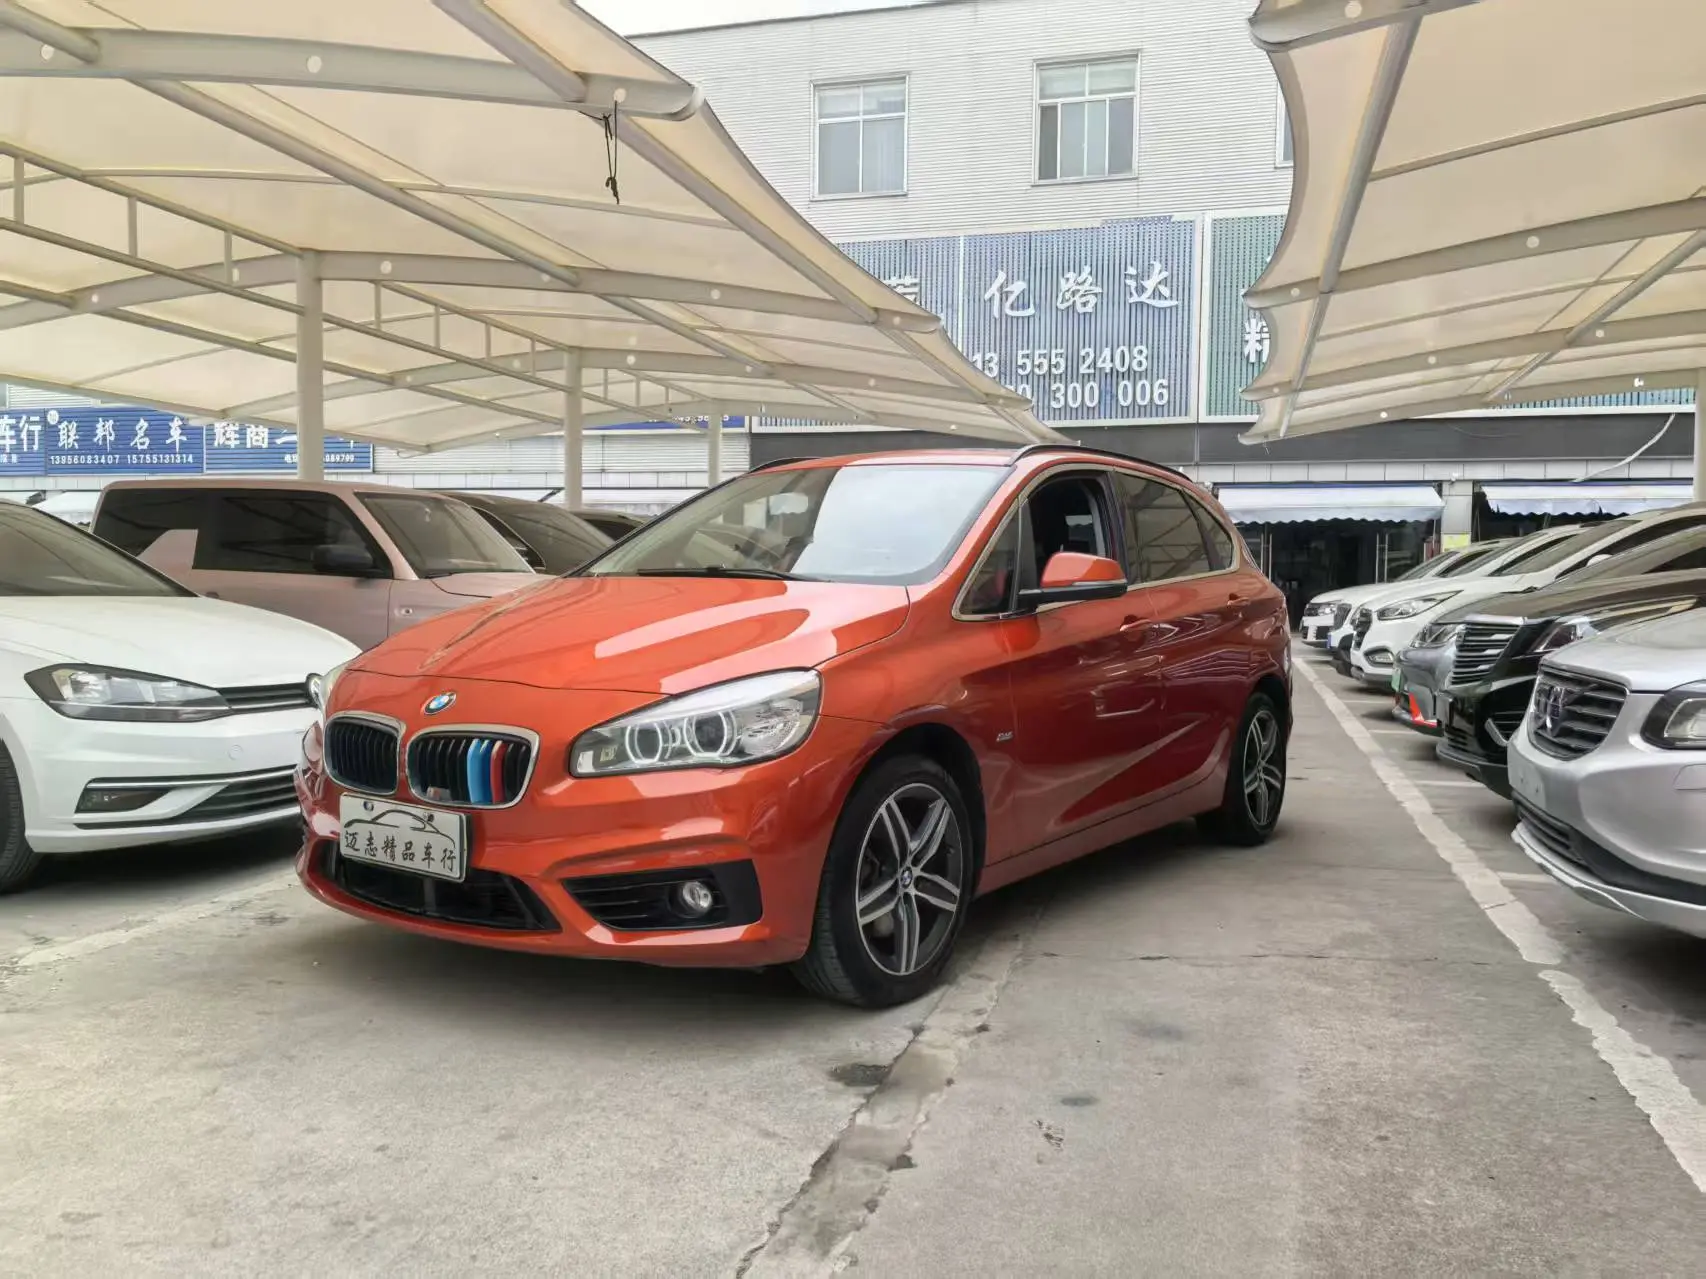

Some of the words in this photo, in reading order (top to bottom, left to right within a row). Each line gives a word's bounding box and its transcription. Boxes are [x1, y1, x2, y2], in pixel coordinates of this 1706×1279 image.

[984, 261, 1179, 319] 亿路达
[1017, 349, 1065, 376] 555
[1079, 345, 1148, 374] 2408
[1050, 381, 1099, 409] 300
[1117, 378, 1169, 407] 006
[58, 415, 188, 453] 联邦名车
[51, 454, 120, 465] 13956083407
[127, 453, 194, 465] 15755131314
[345, 830, 456, 872] 迈志精品车行
